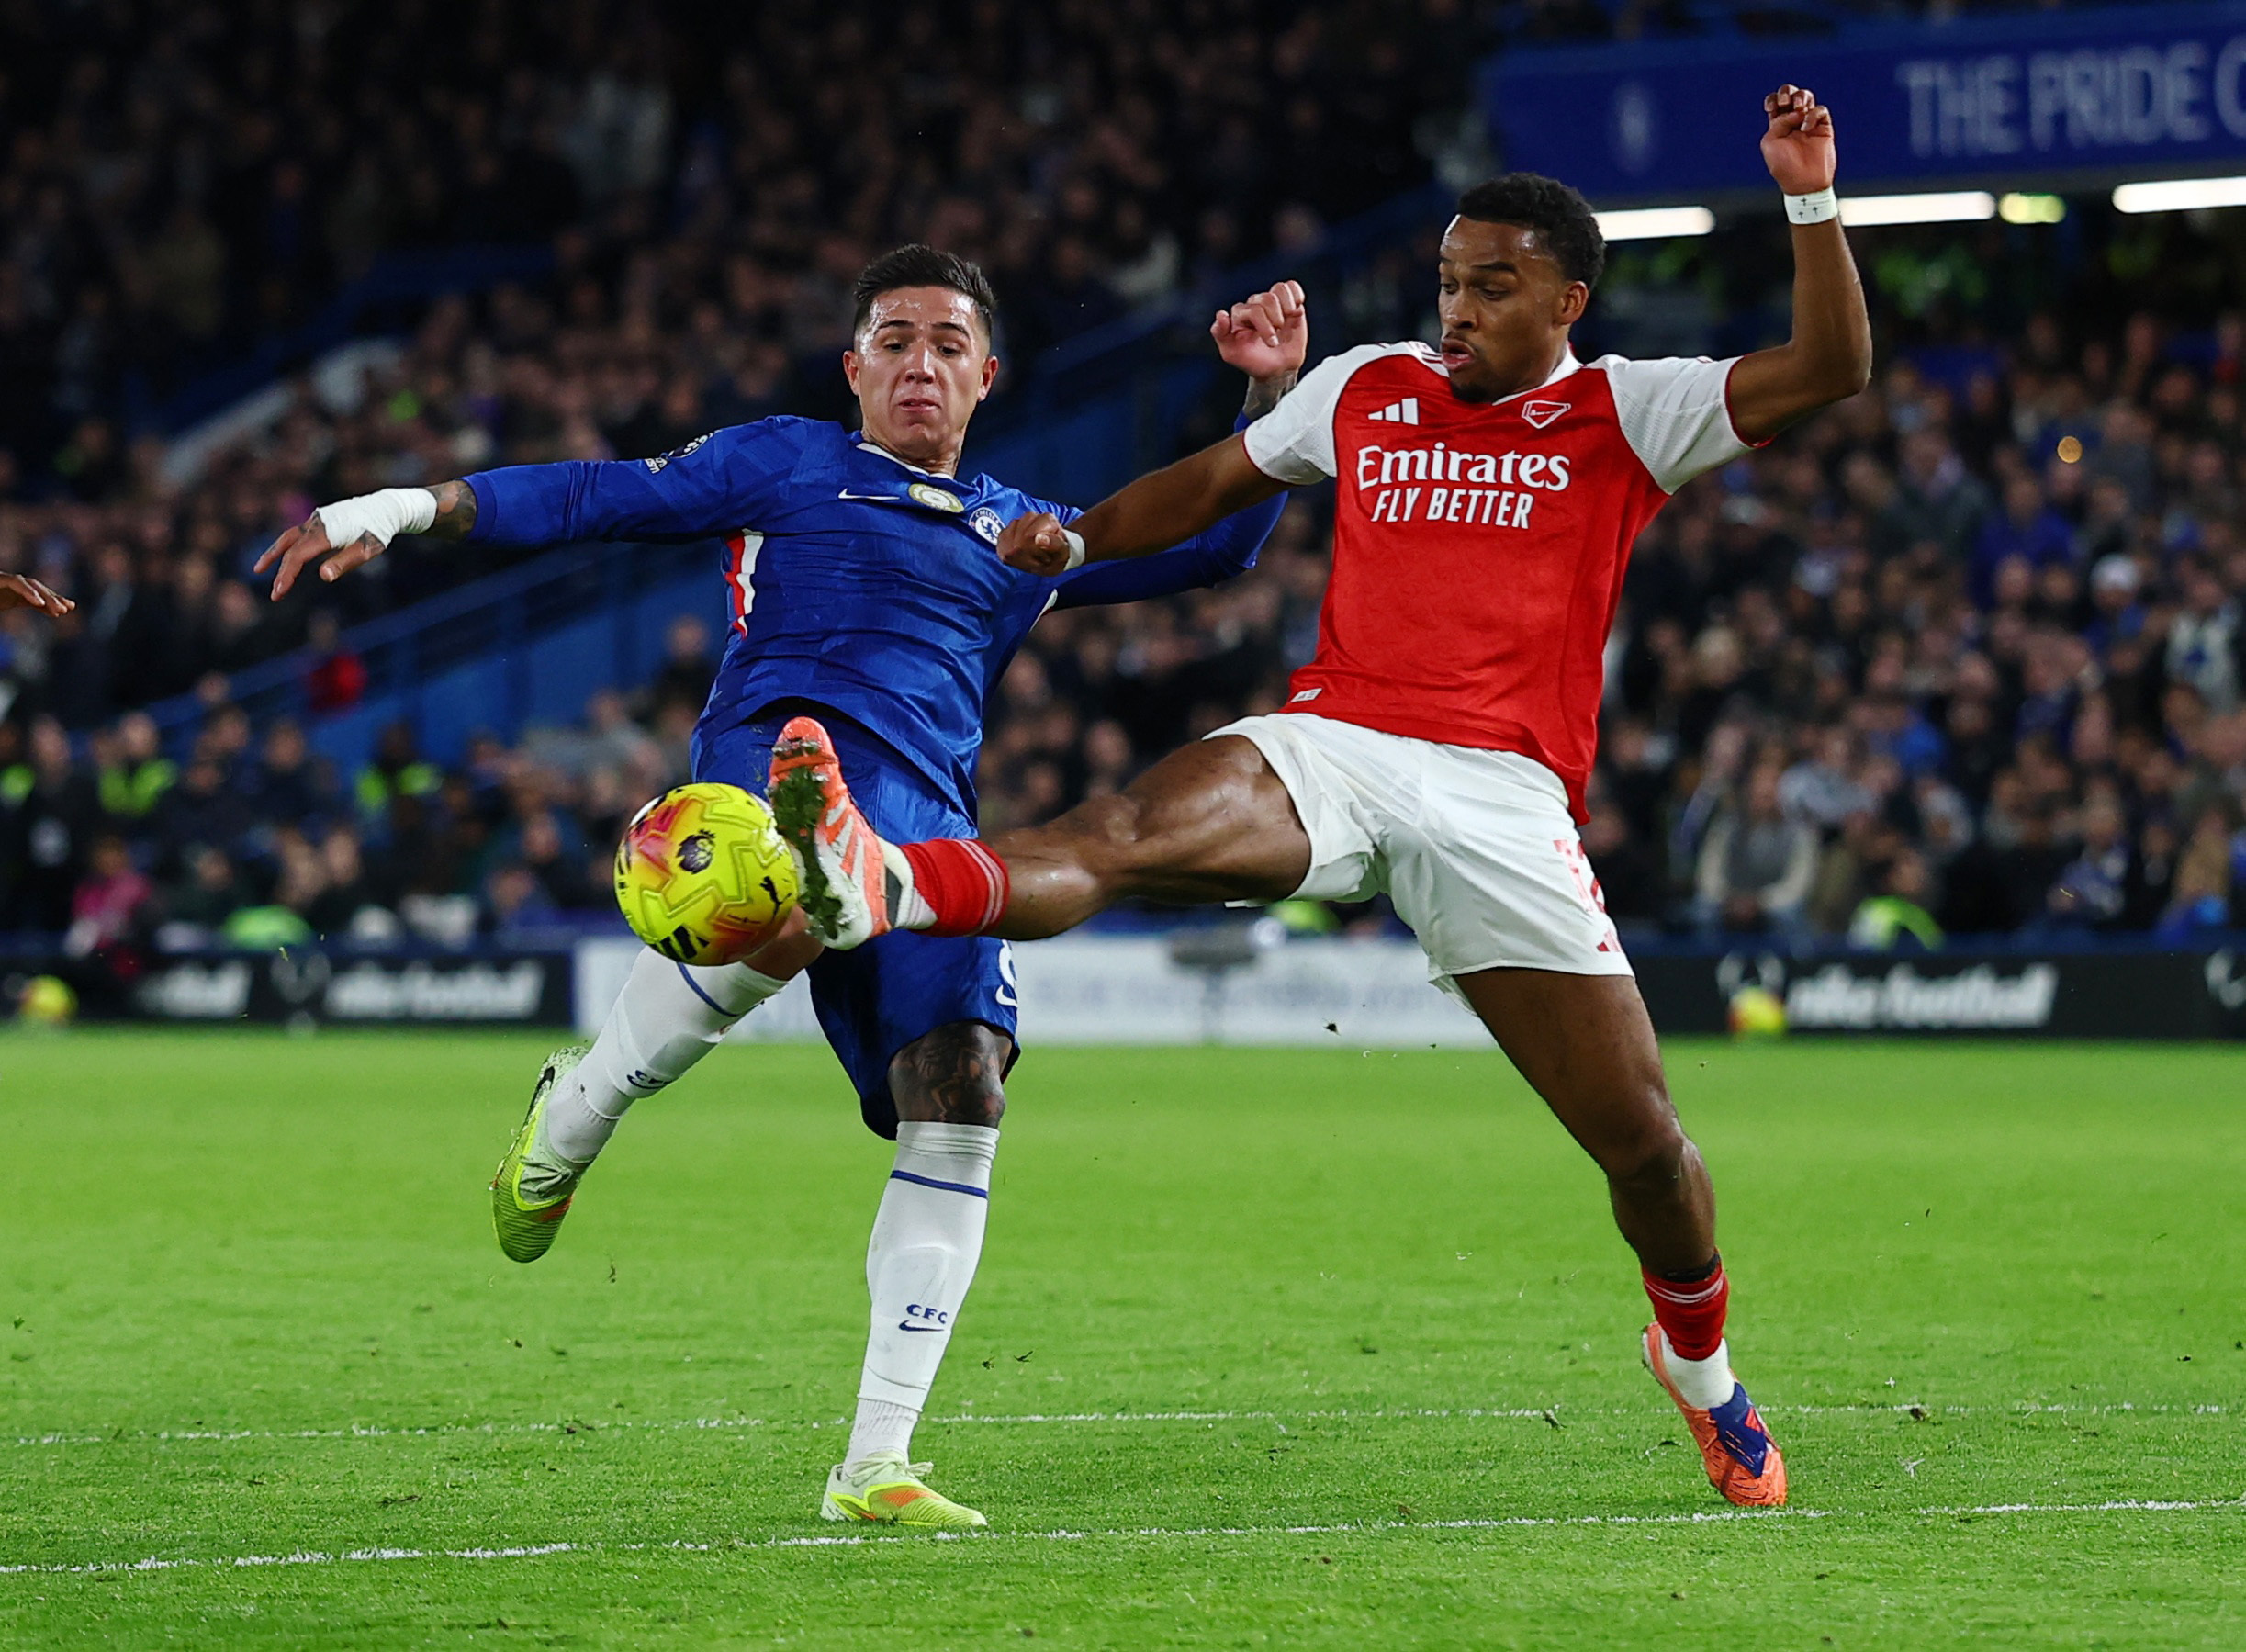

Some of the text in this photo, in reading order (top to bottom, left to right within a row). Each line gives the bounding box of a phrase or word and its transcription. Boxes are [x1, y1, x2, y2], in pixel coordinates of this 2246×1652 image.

[1895, 54, 2022, 156] THE
[2028, 41, 2209, 151] PRIDE
[1356, 442, 1570, 491] Emirates
[1371, 487, 1533, 530] FLY BETTER
[905, 1303, 948, 1324] CFC
